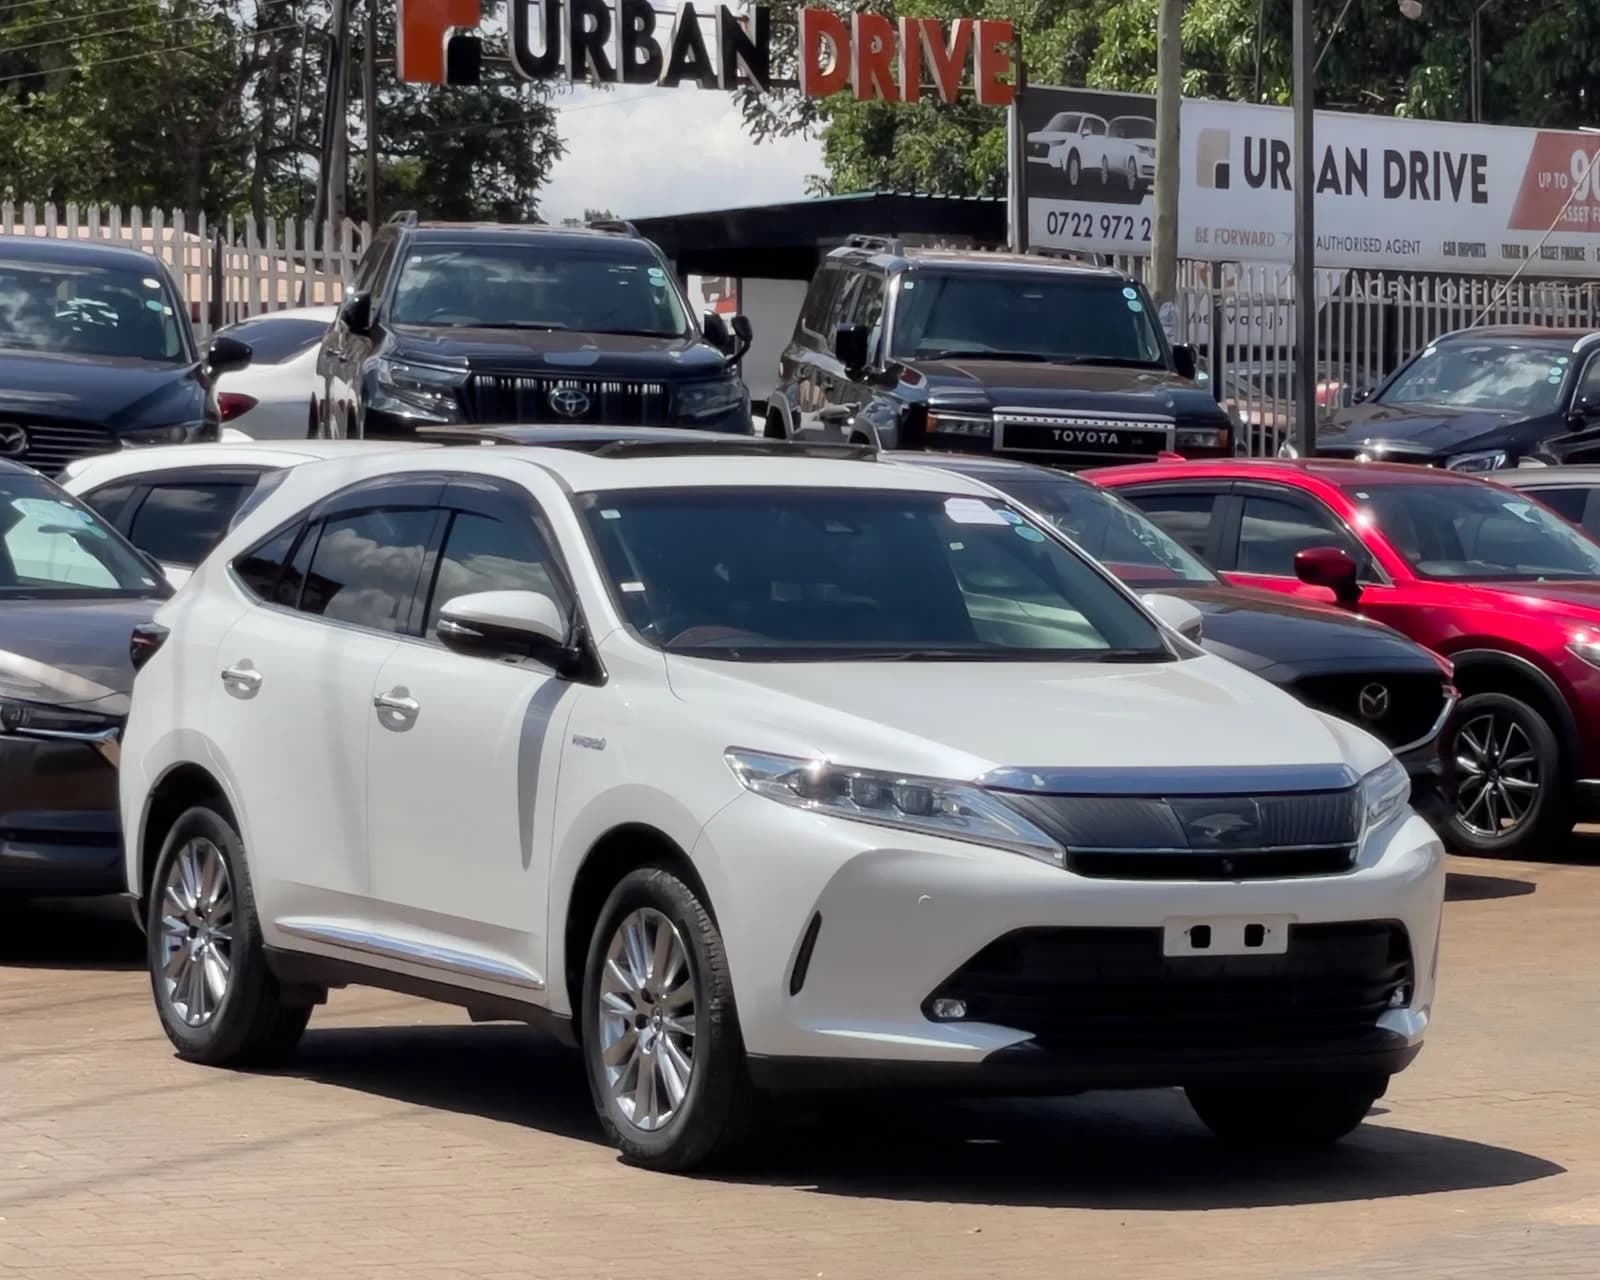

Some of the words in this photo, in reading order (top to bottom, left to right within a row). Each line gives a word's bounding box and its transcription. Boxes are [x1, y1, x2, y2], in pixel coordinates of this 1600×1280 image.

[507, 0, 770, 92] URBAN
[799, 8, 1016, 105] DRIVE
[1243, 136, 1369, 198] URAN
[1383, 149, 1488, 204] DRIVE
[1538, 171, 1551, 189] UP
[1553, 172, 1568, 189] TO
[1046, 211, 1093, 238] 0722
[1100, 214, 1134, 241] 972
[1195, 226, 1209, 244] BE
[1214, 228, 1276, 248] FORWARD
[1315, 235, 1382, 253] AUTHORISED
[1385, 239, 1421, 256] AGENT
[1052, 429, 1119, 445] TOYOTA
